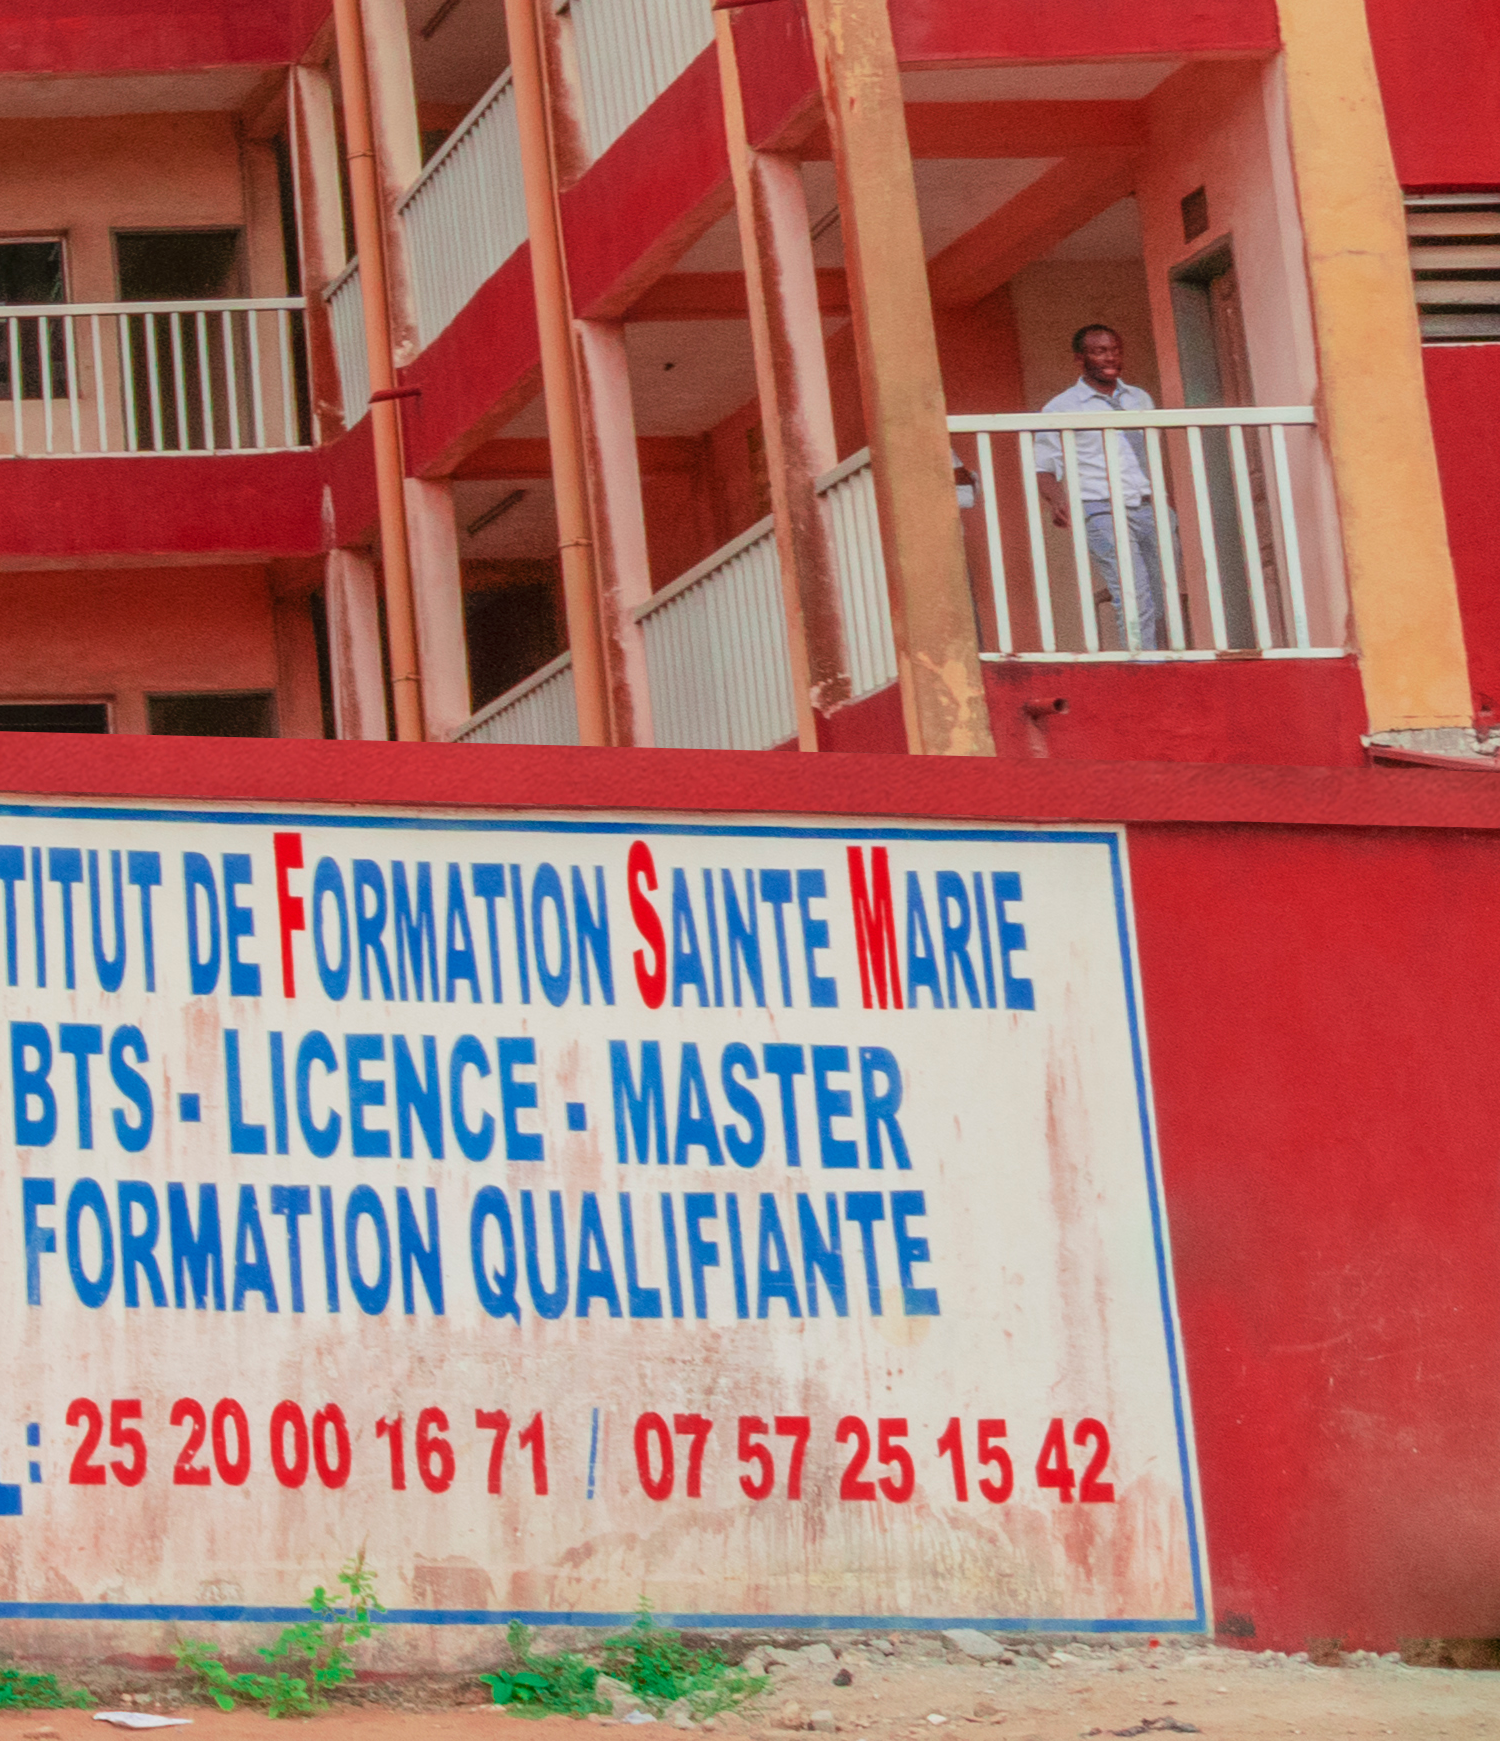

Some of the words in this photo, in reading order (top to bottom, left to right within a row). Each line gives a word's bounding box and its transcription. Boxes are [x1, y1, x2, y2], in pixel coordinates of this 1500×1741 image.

[183, 849, 262, 998] DE
[275, 831, 617, 1008] FORMATION
[627, 839, 838, 1009] SAINTE
[847, 844, 1037, 1011] MARIE
[8, 1020, 155, 1153] BTS
[223, 1028, 546, 1163] LICENCE
[609, 1040, 913, 1171] MASTER
[21, 1177, 446, 1316] FORMATION
[468, 1185, 941, 1326] QUALIFIANTE
[65, 1397, 148, 1488] 25
[169, 1396, 252, 1488] 20
[269, 1399, 353, 1491] 00
[375, 1405, 456, 1495] 16
[475, 1408, 550, 1497] 71
[633, 1411, 714, 1502] 07
[737, 1415, 812, 1502] 57
[835, 1415, 916, 1505] 25
[937, 1416, 1014, 1506] 15
[1035, 1417, 1117, 1506] 42
